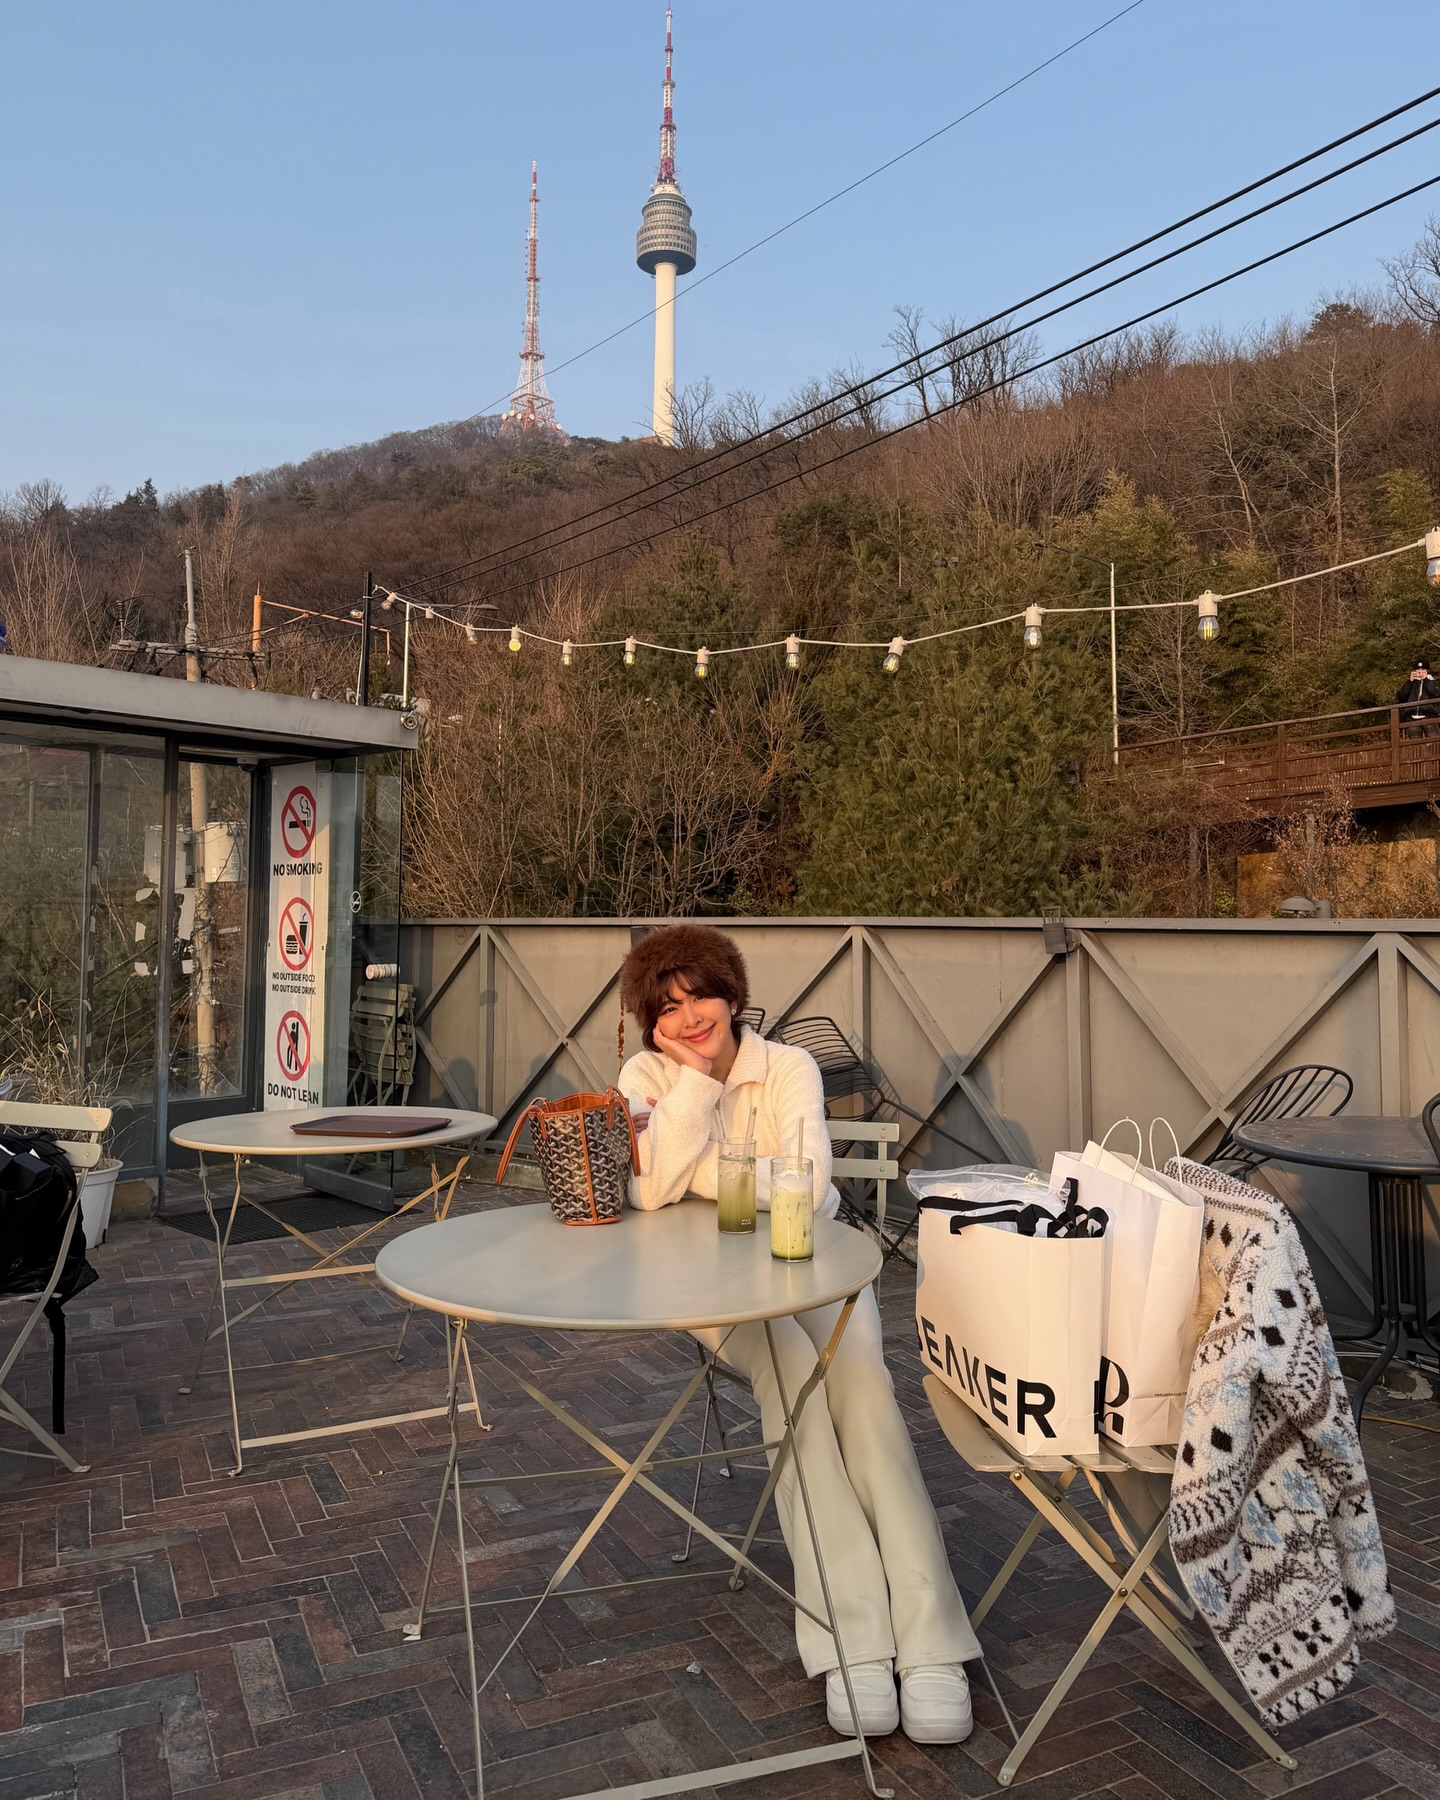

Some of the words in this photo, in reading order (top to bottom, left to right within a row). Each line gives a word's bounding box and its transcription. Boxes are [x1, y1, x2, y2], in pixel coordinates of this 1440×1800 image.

[273, 864, 285, 876] NO
[286, 862, 323, 876] SMOKING
[272, 972, 279, 980] NO
[280, 972, 302, 982] OUTSIDE
[272, 984, 279, 992] NO
[280, 985, 302, 994] OUTSIDE
[268, 1083, 279, 1096] DO
[281, 1085, 297, 1100] NOT
[298, 1089, 319, 1105] LEAN
